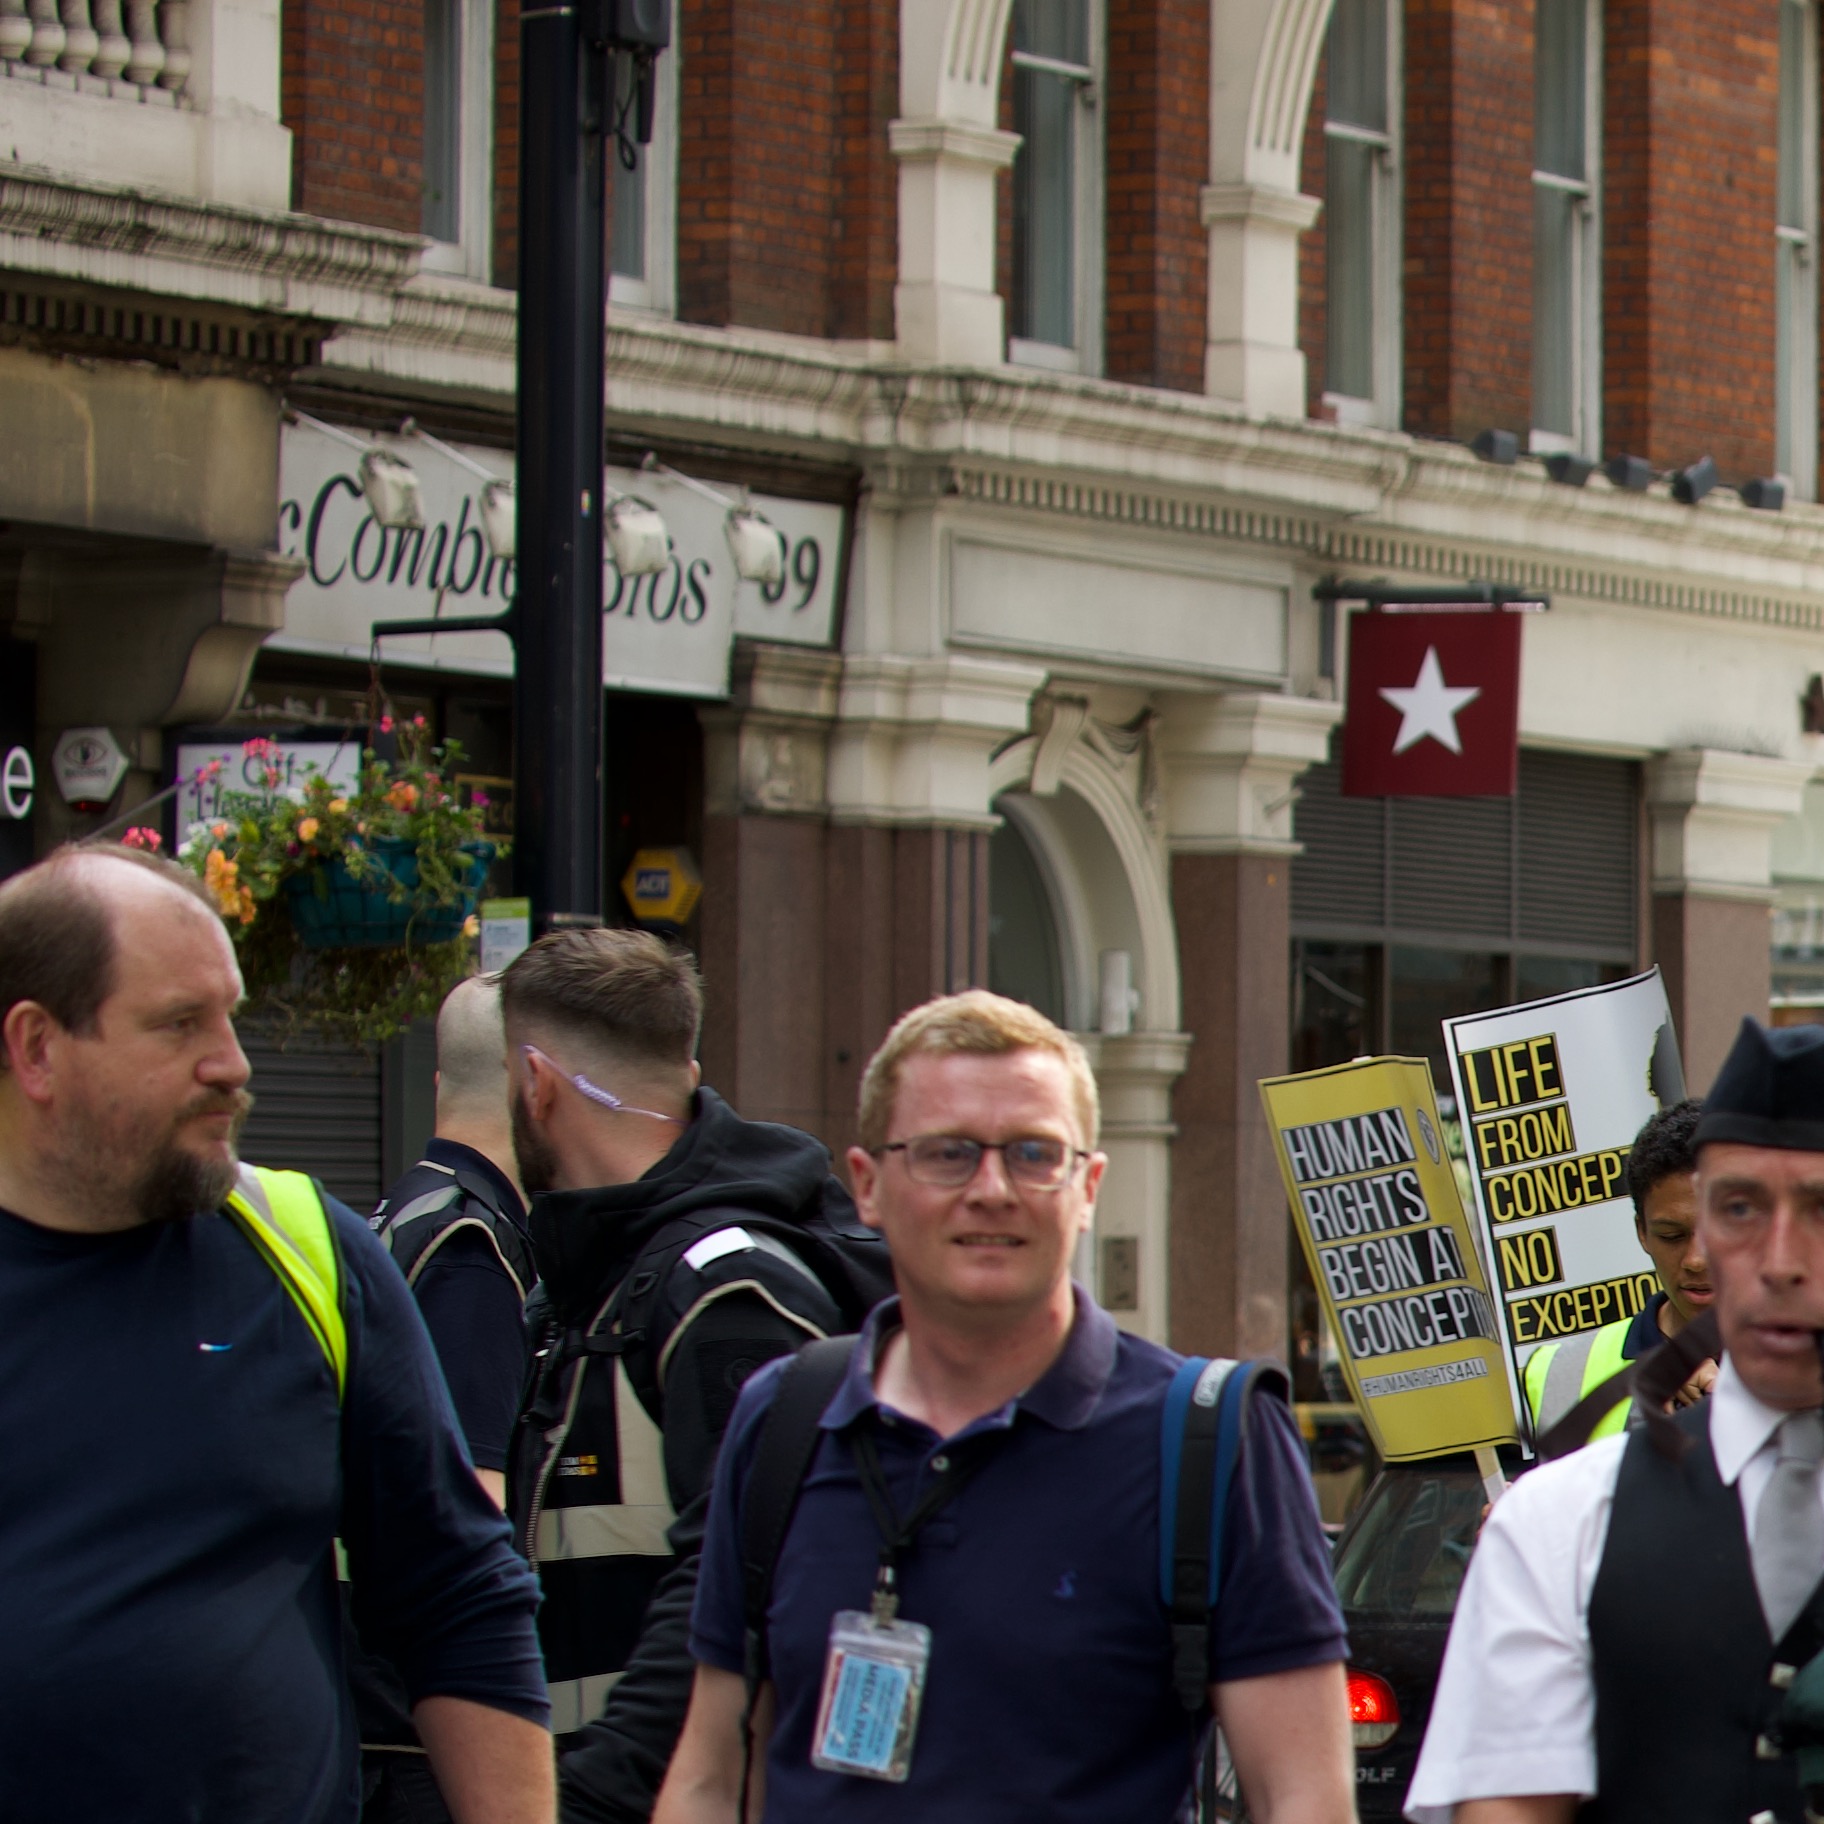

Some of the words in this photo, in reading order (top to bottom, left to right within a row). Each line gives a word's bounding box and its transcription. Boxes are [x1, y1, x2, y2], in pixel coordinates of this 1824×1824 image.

[1463, 1036, 1561, 1112] LIFE
[1282, 1107, 1416, 1182] HUMAN
[1476, 1106, 1574, 1169] FROM
[1300, 1169, 1429, 1242] RIGHTS
[1487, 1149, 1632, 1222] CONCEP
[1319, 1234, 1425, 1301] BEGIN
[1427, 1227, 1466, 1281] AT
[1500, 1231, 1556, 1290] NO
[1510, 1273, 1664, 1342] EXCEPTIO
[1363, 1357, 1488, 1396] #HUMANRIGHTS4ALL
[1356, 1767, 1395, 1783] OLF
